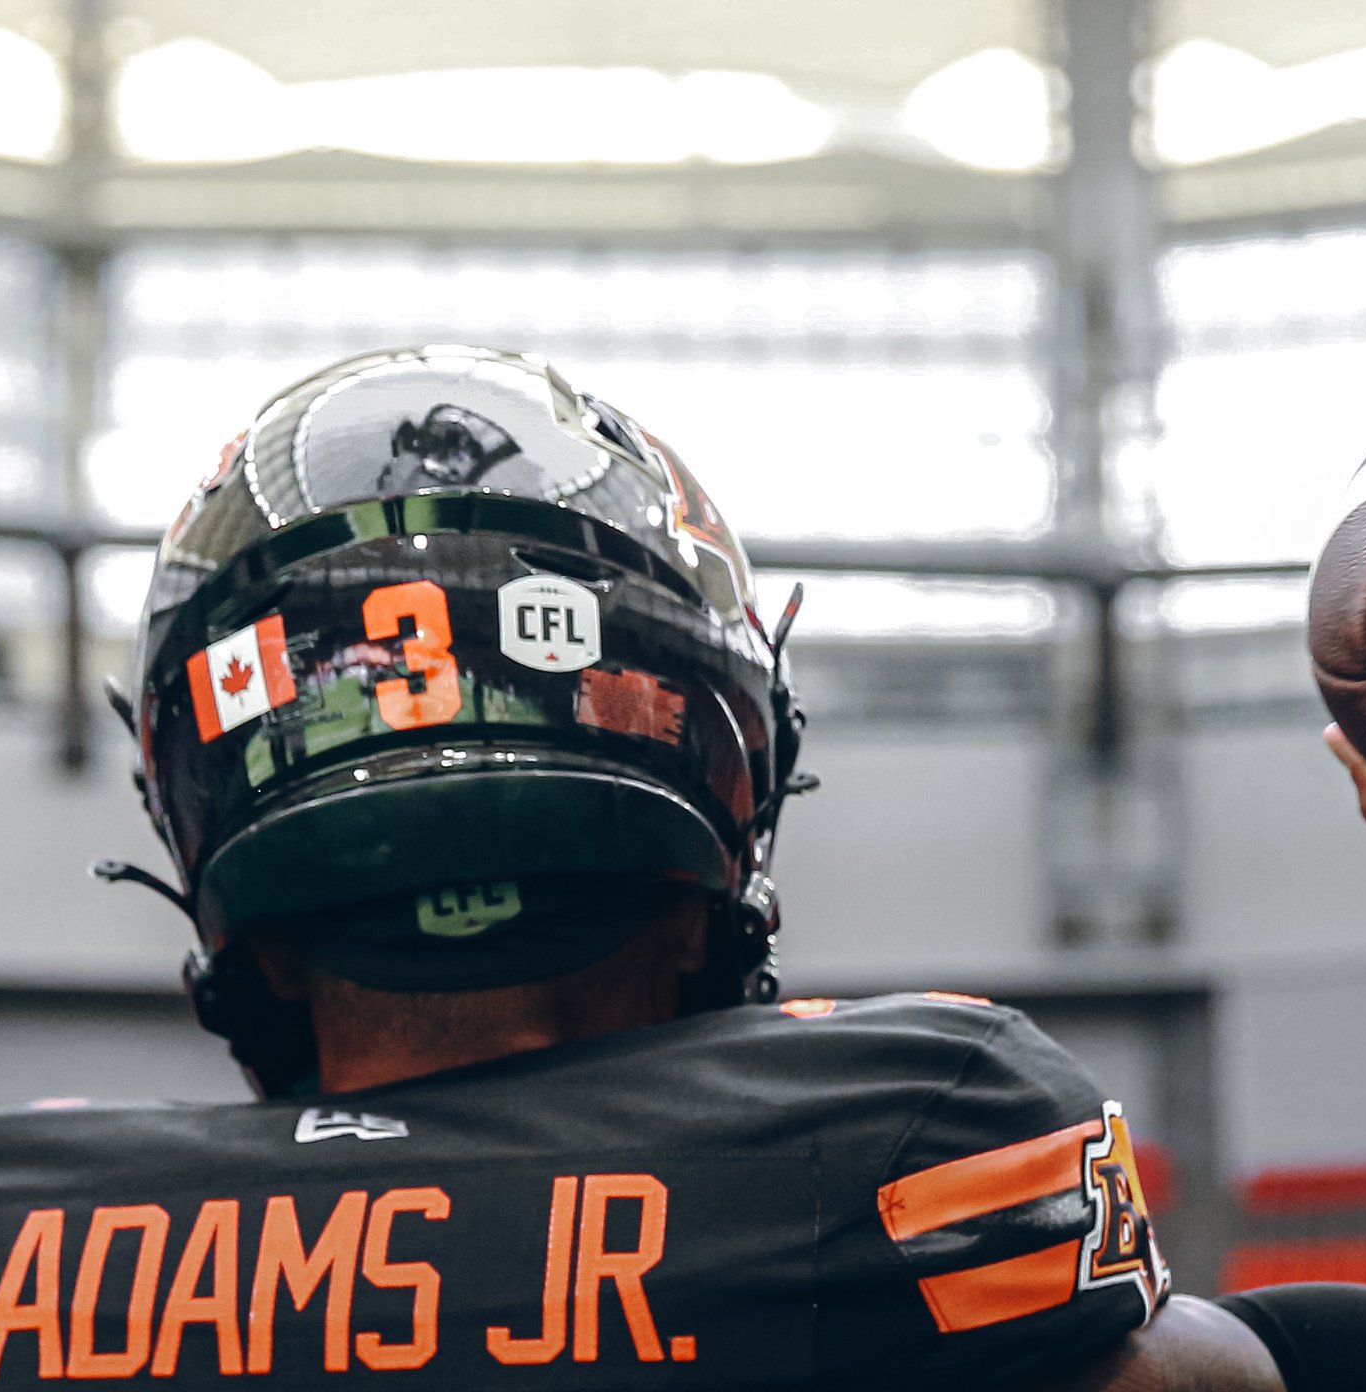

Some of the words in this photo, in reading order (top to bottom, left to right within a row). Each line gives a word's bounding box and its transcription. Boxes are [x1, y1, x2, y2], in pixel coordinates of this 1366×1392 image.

[362, 580, 462, 731] 3
[517, 603, 585, 645] CFL
[485, 1172, 697, 1366] JR.
